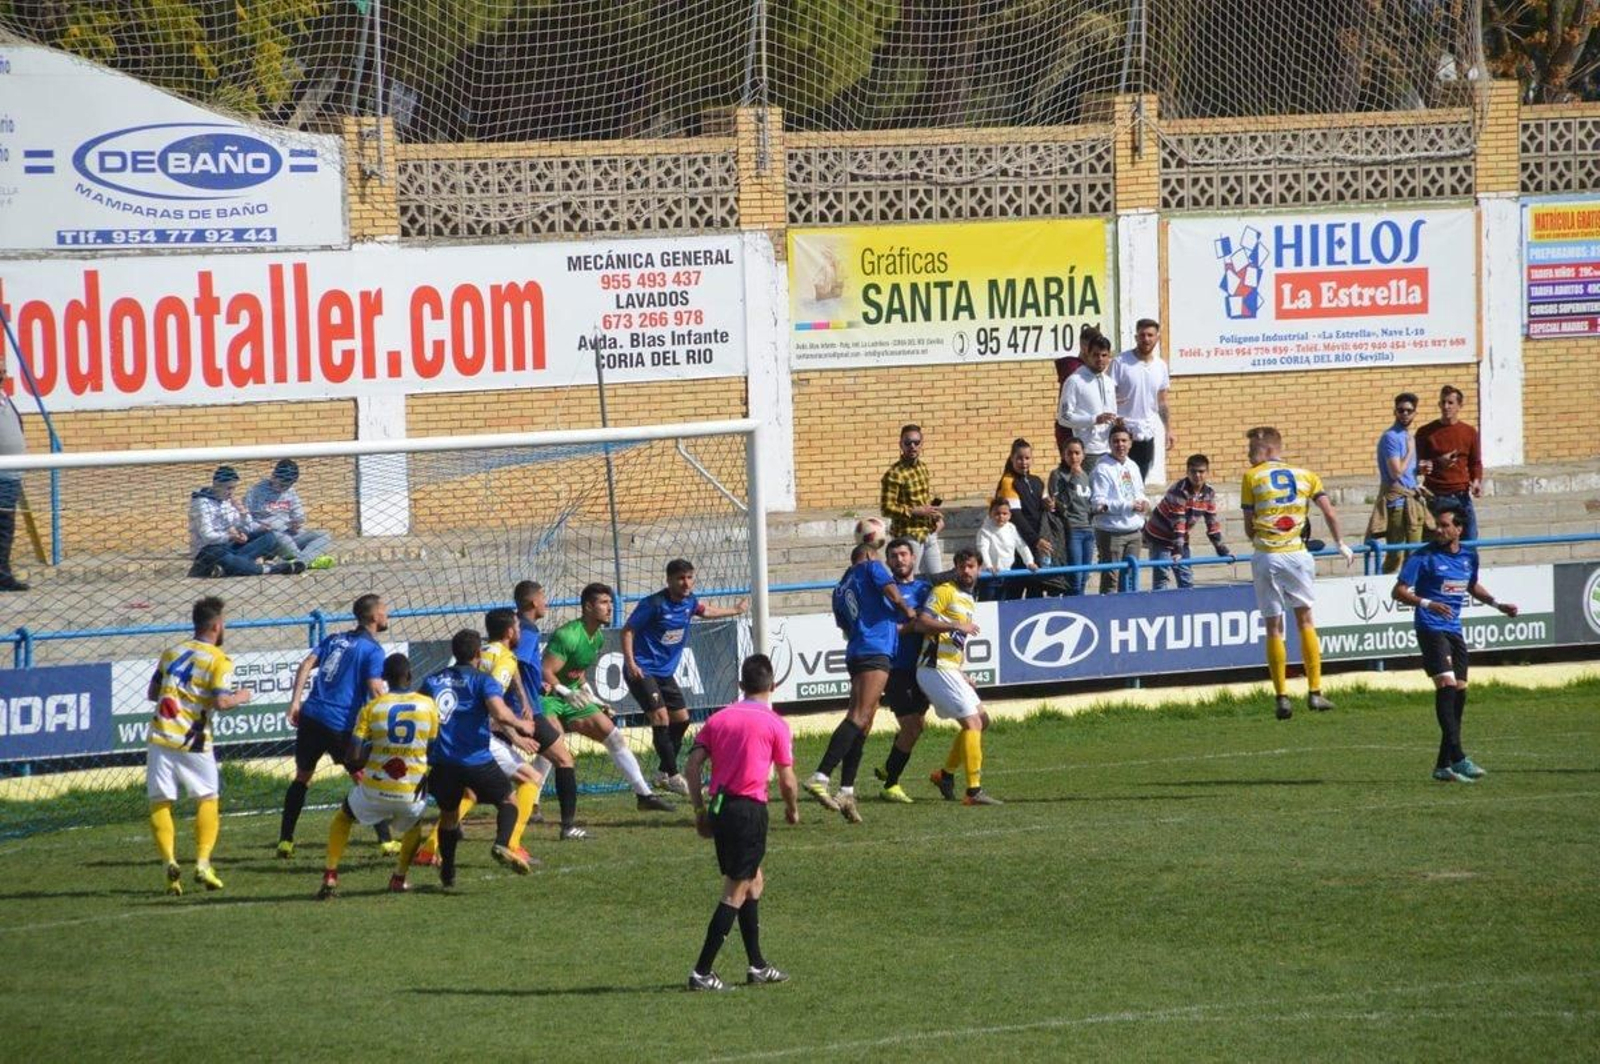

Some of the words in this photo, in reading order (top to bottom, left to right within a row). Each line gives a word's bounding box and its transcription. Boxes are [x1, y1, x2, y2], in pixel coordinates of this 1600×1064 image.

[98, 151, 156, 173] DE
[167, 145, 271, 174] BAÑO
[75, 183, 184, 220] MAMPARAS
[188, 208, 212, 220] DE
[216, 202, 269, 218] BAÑO
[60, 231, 102, 244] Tlf.
[112, 229, 157, 243] 954
[166, 229, 194, 242] 77
[205, 229, 235, 242] 92
[242, 228, 273, 242] 44
[1274, 219, 1427, 268] HIELOS
[567, 250, 656, 272] MECÁNICA
[660, 249, 734, 268] GENERAL
[860, 246, 949, 276] Gráficas
[600, 274, 632, 291] 955
[636, 271, 668, 289] 493
[672, 270, 702, 287] 437
[861, 279, 976, 325] SANTA
[987, 265, 1102, 320] MARÍA
[1281, 282, 1313, 311] La
[1319, 276, 1423, 309] Estrella
[615, 290, 690, 310] LAVADOS
[602, 313, 633, 330] 673
[638, 311, 669, 328] 266
[674, 309, 704, 327] 978
[577, 334, 624, 351] Avda.
[630, 332, 666, 349] Blas
[671, 328, 730, 346] Infante
[976, 327, 1001, 356] 95
[1008, 325, 1044, 354] 477
[1050, 323, 1074, 352] 10
[1262, 331, 1309, 342] Industrial
[1380, 328, 1403, 337] Nave
[595, 351, 646, 370] CORIA
[651, 349, 681, 367] DEL
[686, 348, 714, 365] RIO
[1279, 354, 1311, 365] CORIA
[1313, 353, 1333, 363] DEL
[1334, 352, 1353, 363] RÍO
[1353, 351, 1395, 363] (Sevilla)
[1269, 468, 1297, 505] 9
[166, 649, 195, 688] 4
[234, 661, 302, 677] GRUPO
[321, 647, 346, 682] 4
[800, 682, 838, 696] CORIA
[0, 692, 91, 737] DAI
[434, 687, 459, 725] 9
[387, 703, 416, 745] 6
